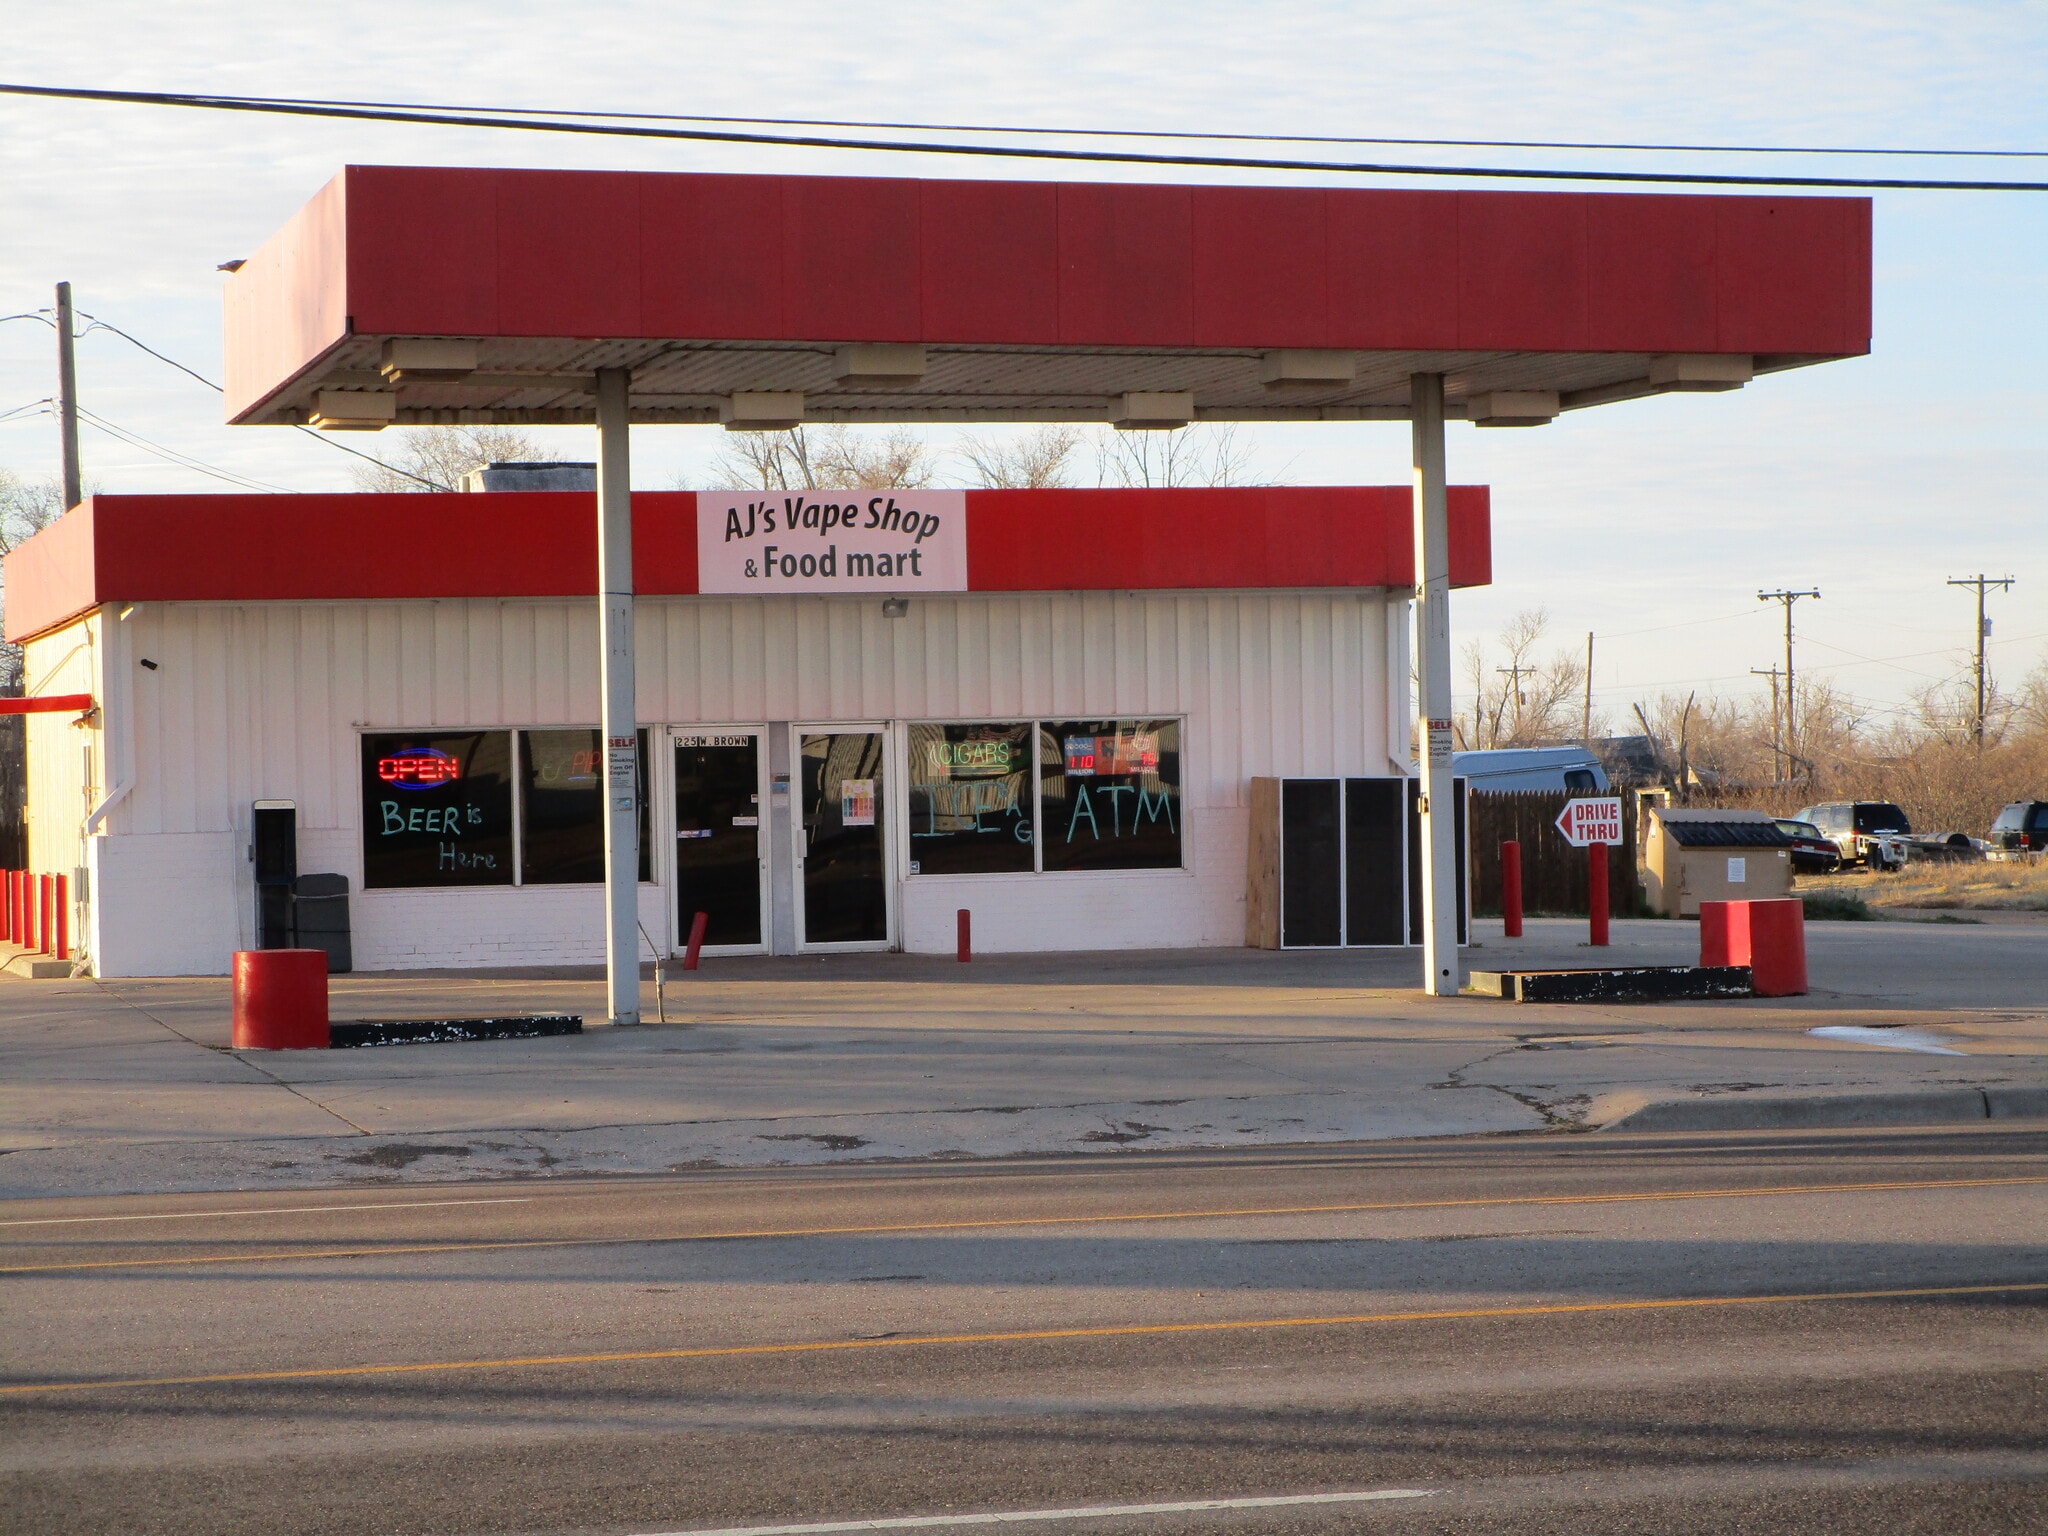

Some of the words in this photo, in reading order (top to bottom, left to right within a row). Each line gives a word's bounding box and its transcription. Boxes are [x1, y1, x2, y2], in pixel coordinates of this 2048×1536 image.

[725, 501, 776, 542] AJ's
[784, 497, 858, 536] Vape
[864, 497, 940, 544] Shop
[744, 558, 758, 578] &
[764, 544, 836, 578] Food
[846, 548, 922, 577] mart
[1428, 720, 1452, 730] SELF
[608, 738, 635, 748] SELF
[677, 736, 697, 747] 225
[714, 736, 747, 746] BROWN
[939, 742, 1009, 766] CIGARS
[1069, 755, 1095, 769] 110
[379, 758, 457, 780] OPEN
[1067, 768, 1094, 776] MILLION
[380, 801, 461, 836] BEER
[466, 803, 483, 825] is
[1066, 783, 1175, 844] ATM
[1576, 803, 1617, 821] DRIVE
[1577, 822, 1618, 841] THRU
[438, 841, 497, 871] Here
